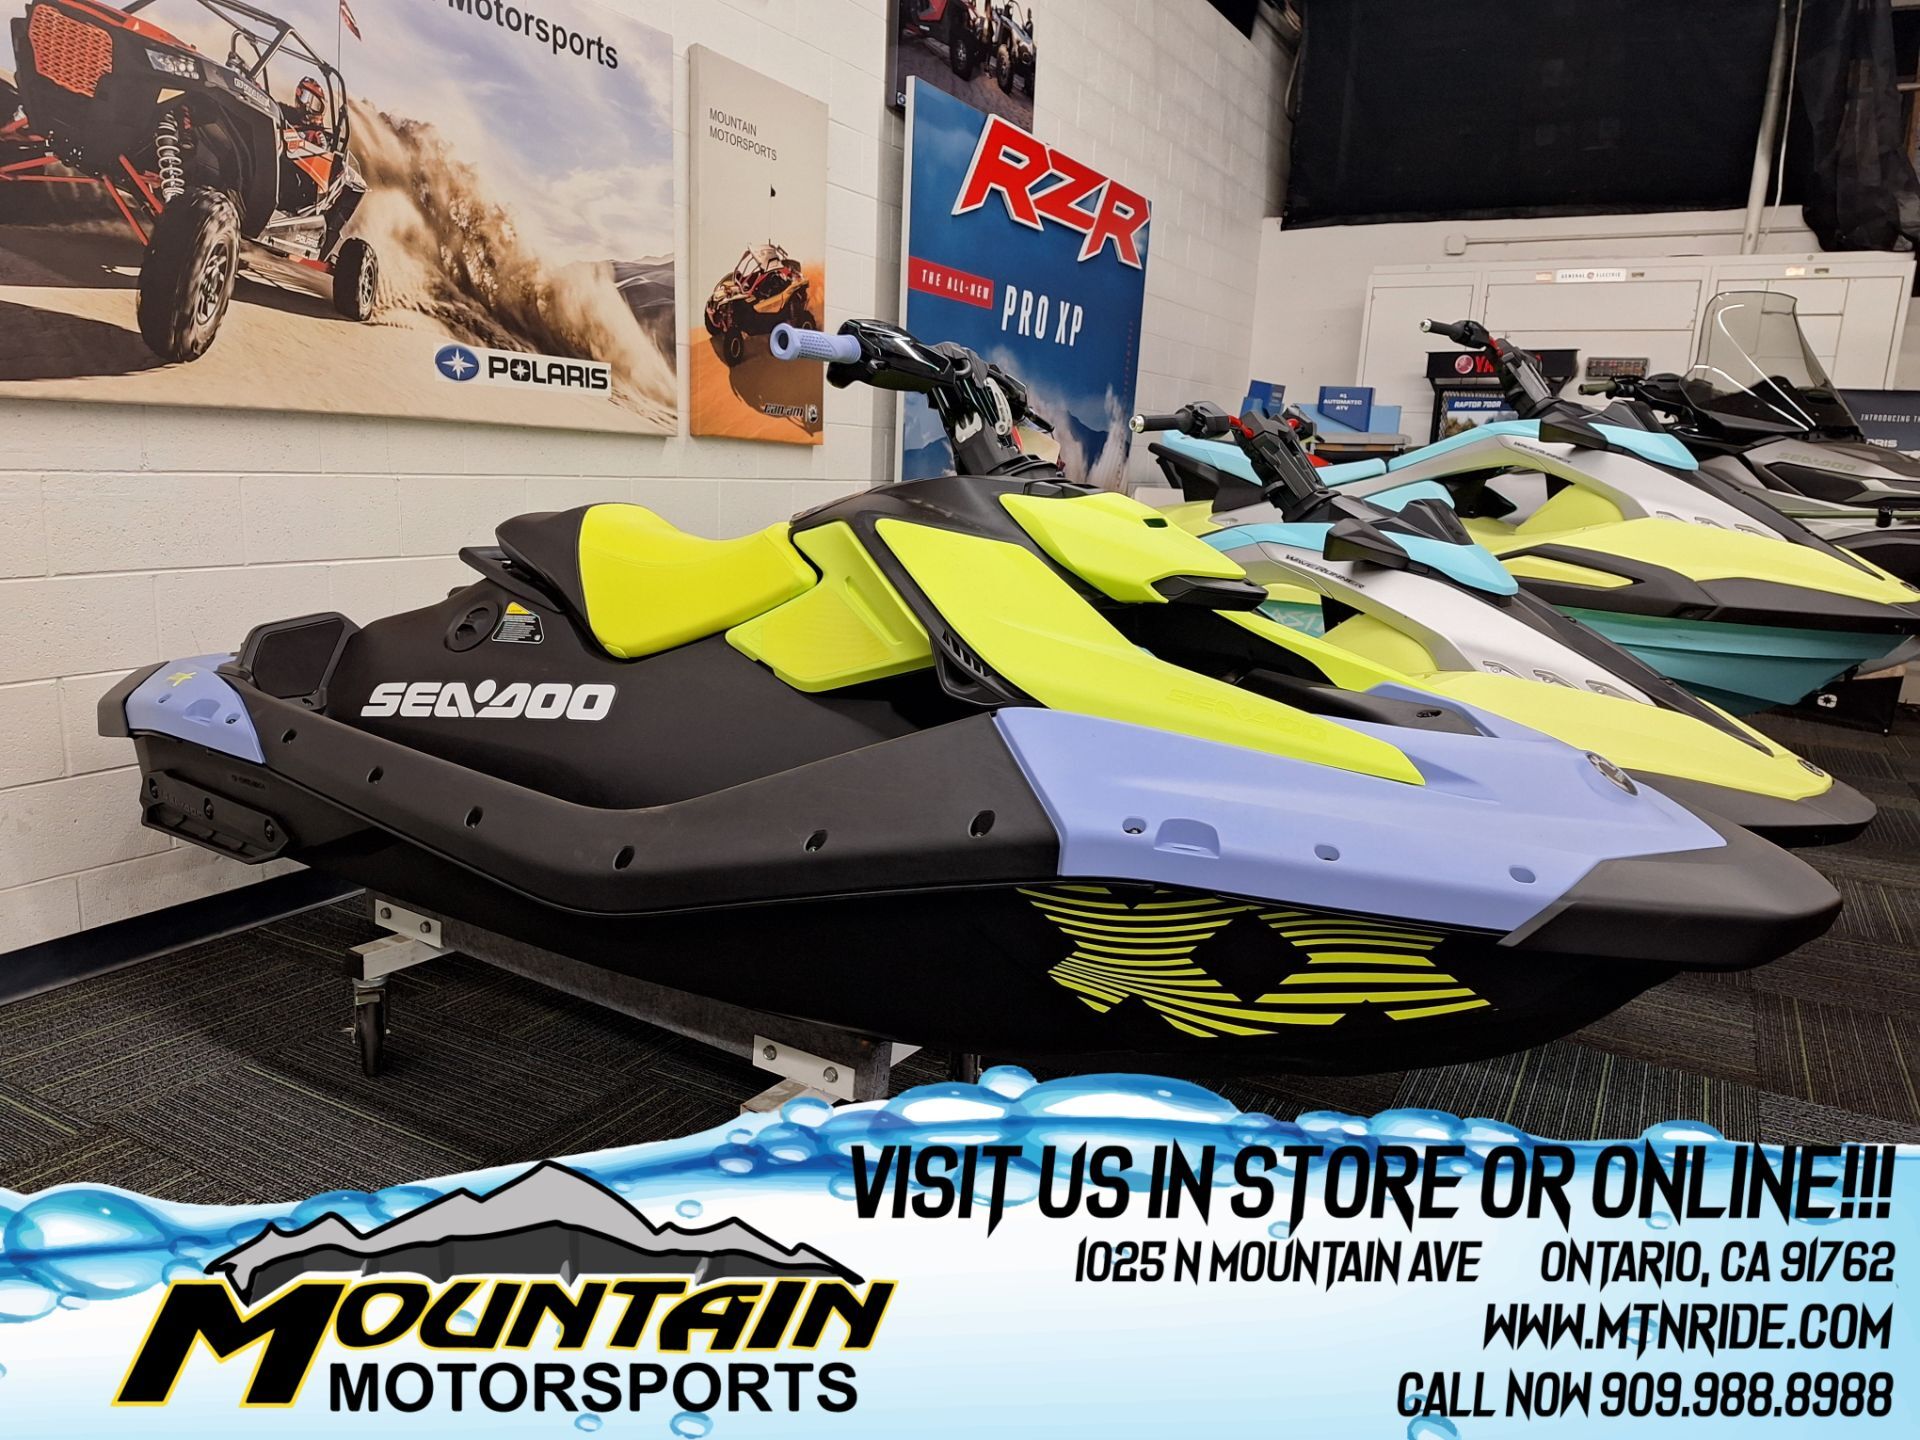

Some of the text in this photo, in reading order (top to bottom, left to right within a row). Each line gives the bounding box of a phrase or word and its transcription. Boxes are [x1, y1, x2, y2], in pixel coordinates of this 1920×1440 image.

[709, 107, 757, 136] MOUNTAIN
[709, 125, 777, 160] MOTORSPORTS
[951, 113, 1150, 269] RZR
[922, 269, 990, 300] THE ALL-NEW
[1001, 284, 1083, 346] PRO XP
[488, 355, 608, 390] POLARIS
[1454, 400, 1481, 409] RAPTOR
[1860, 413, 1910, 423] INTRODUCING
